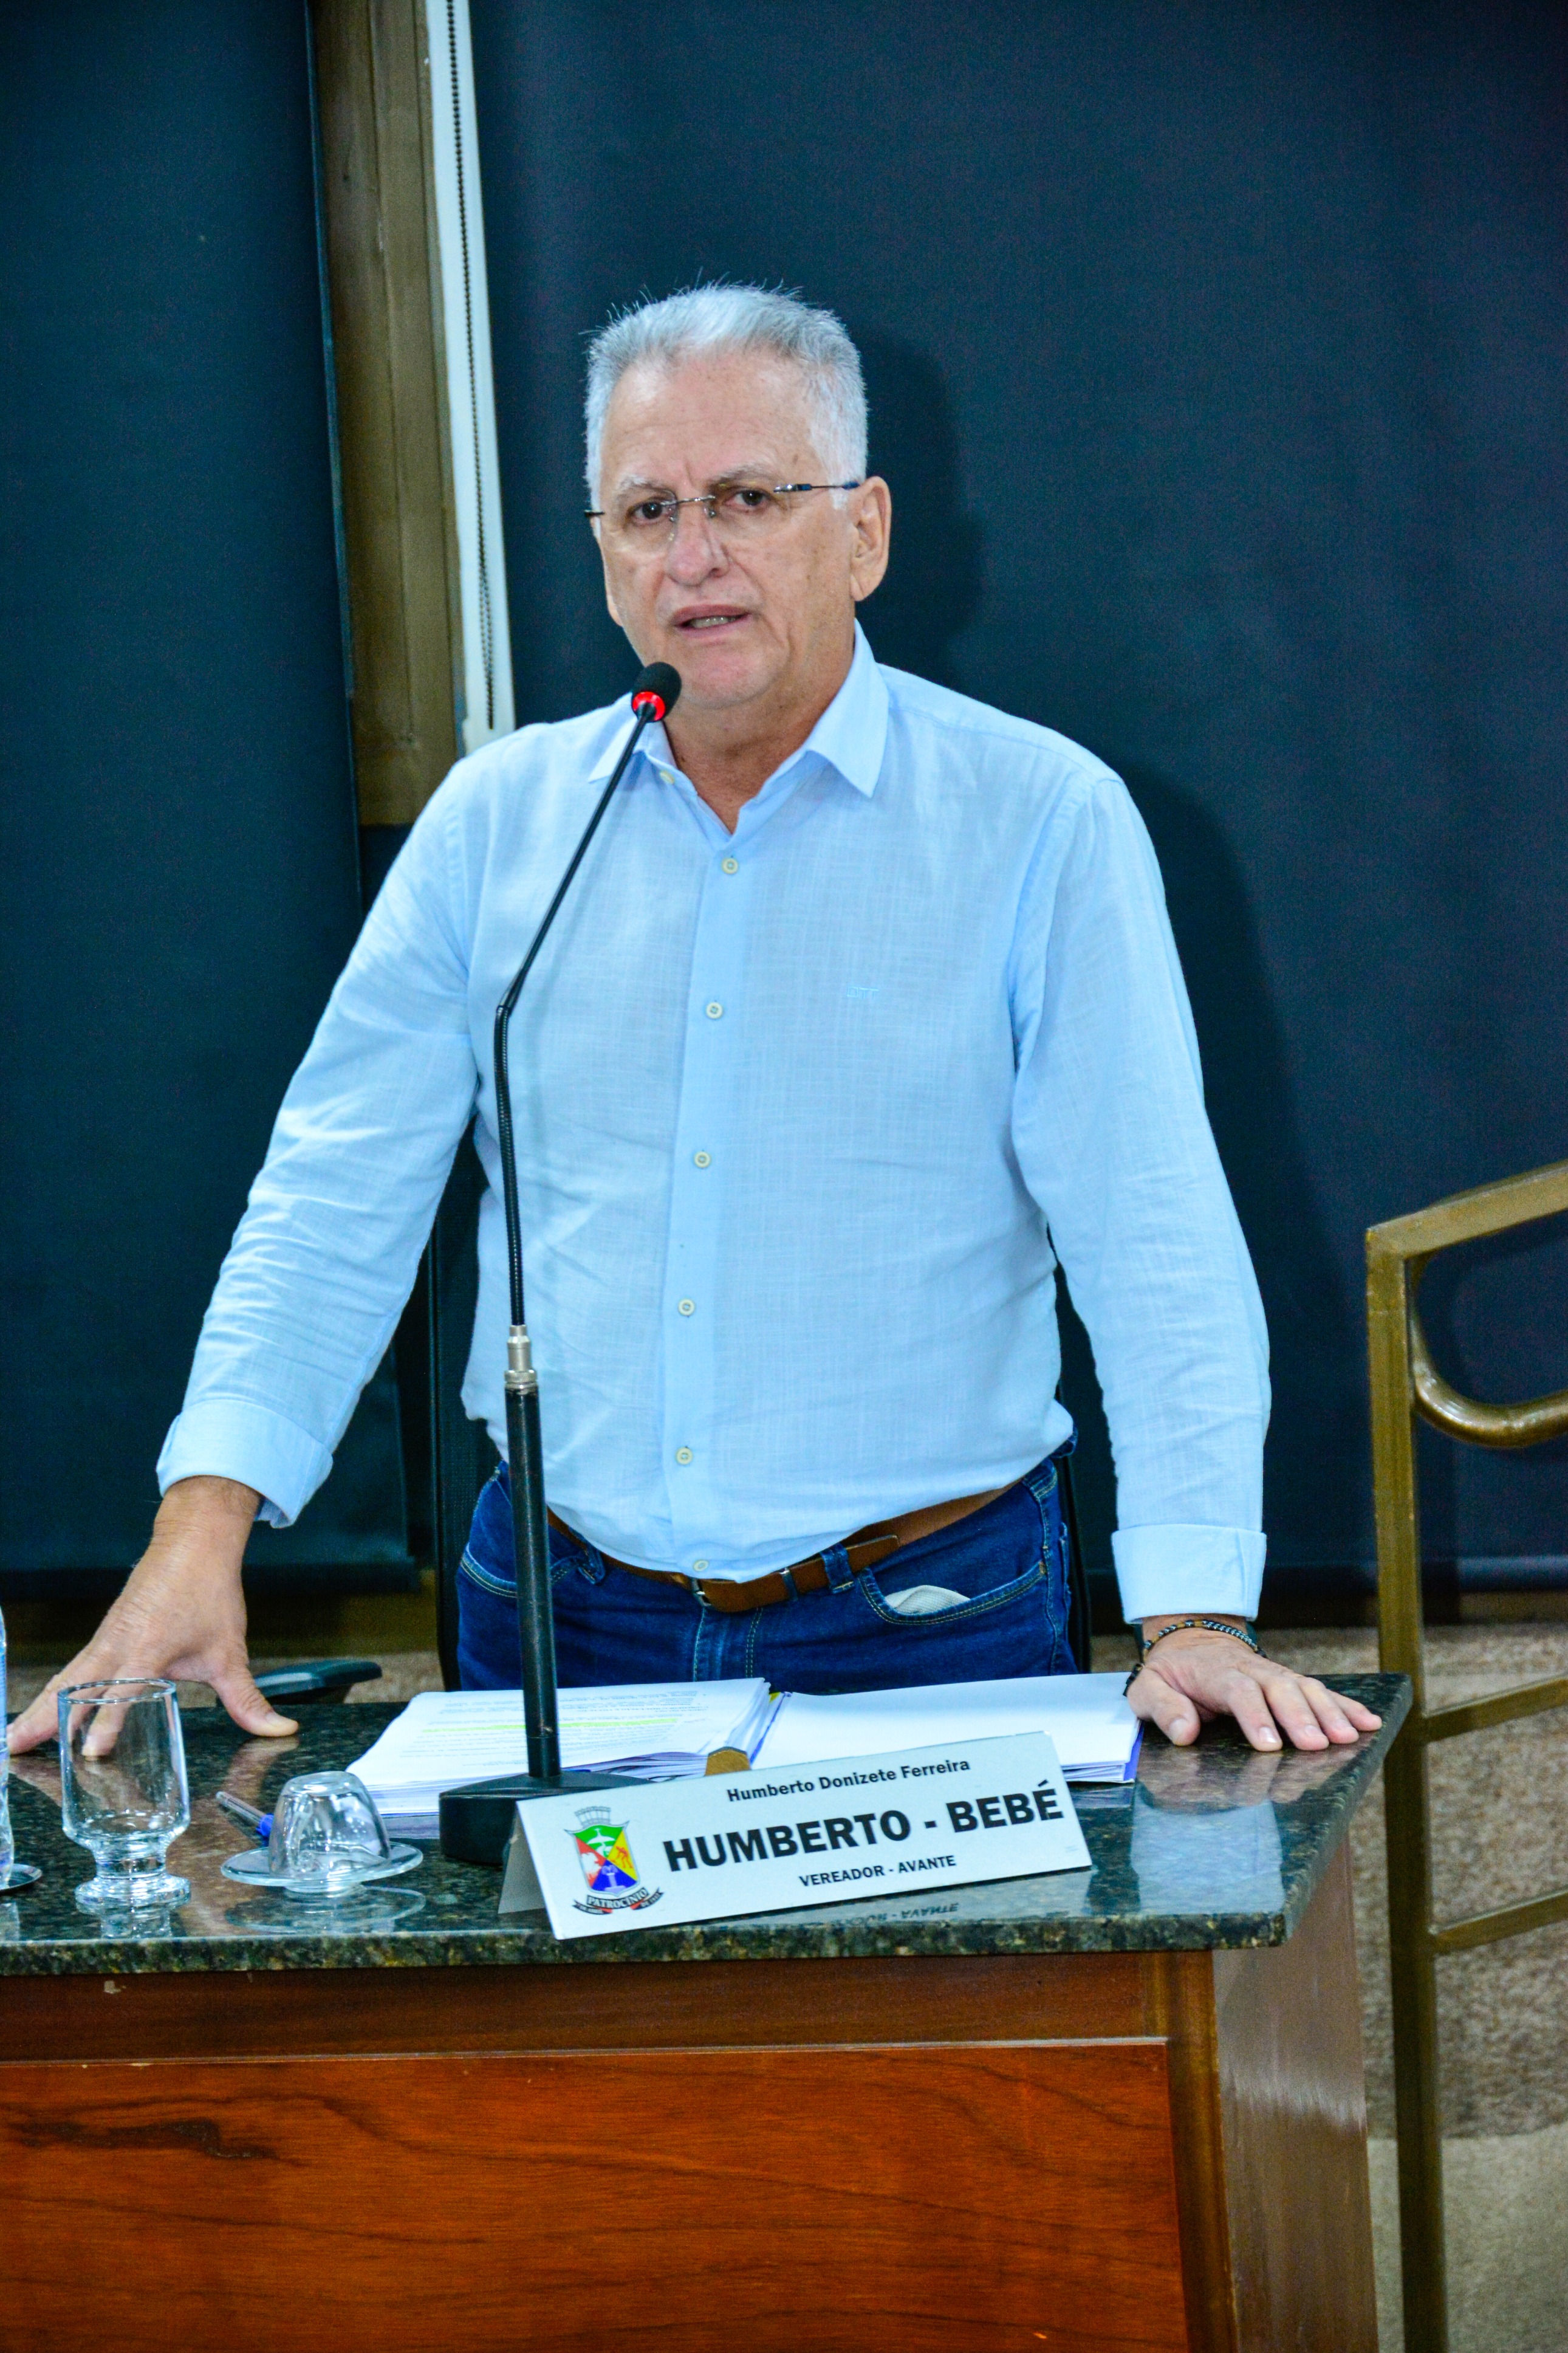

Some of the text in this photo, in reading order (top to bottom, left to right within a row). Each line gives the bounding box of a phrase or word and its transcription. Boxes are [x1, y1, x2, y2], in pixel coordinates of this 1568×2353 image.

[727, 1760, 971, 1802] Humberto Donizete Ferreira
[663, 1779, 1064, 1872] HUMBERTO - BEBÉ
[799, 1865, 885, 1886] VEREADOR
[899, 1855, 956, 1873] AVANTE
